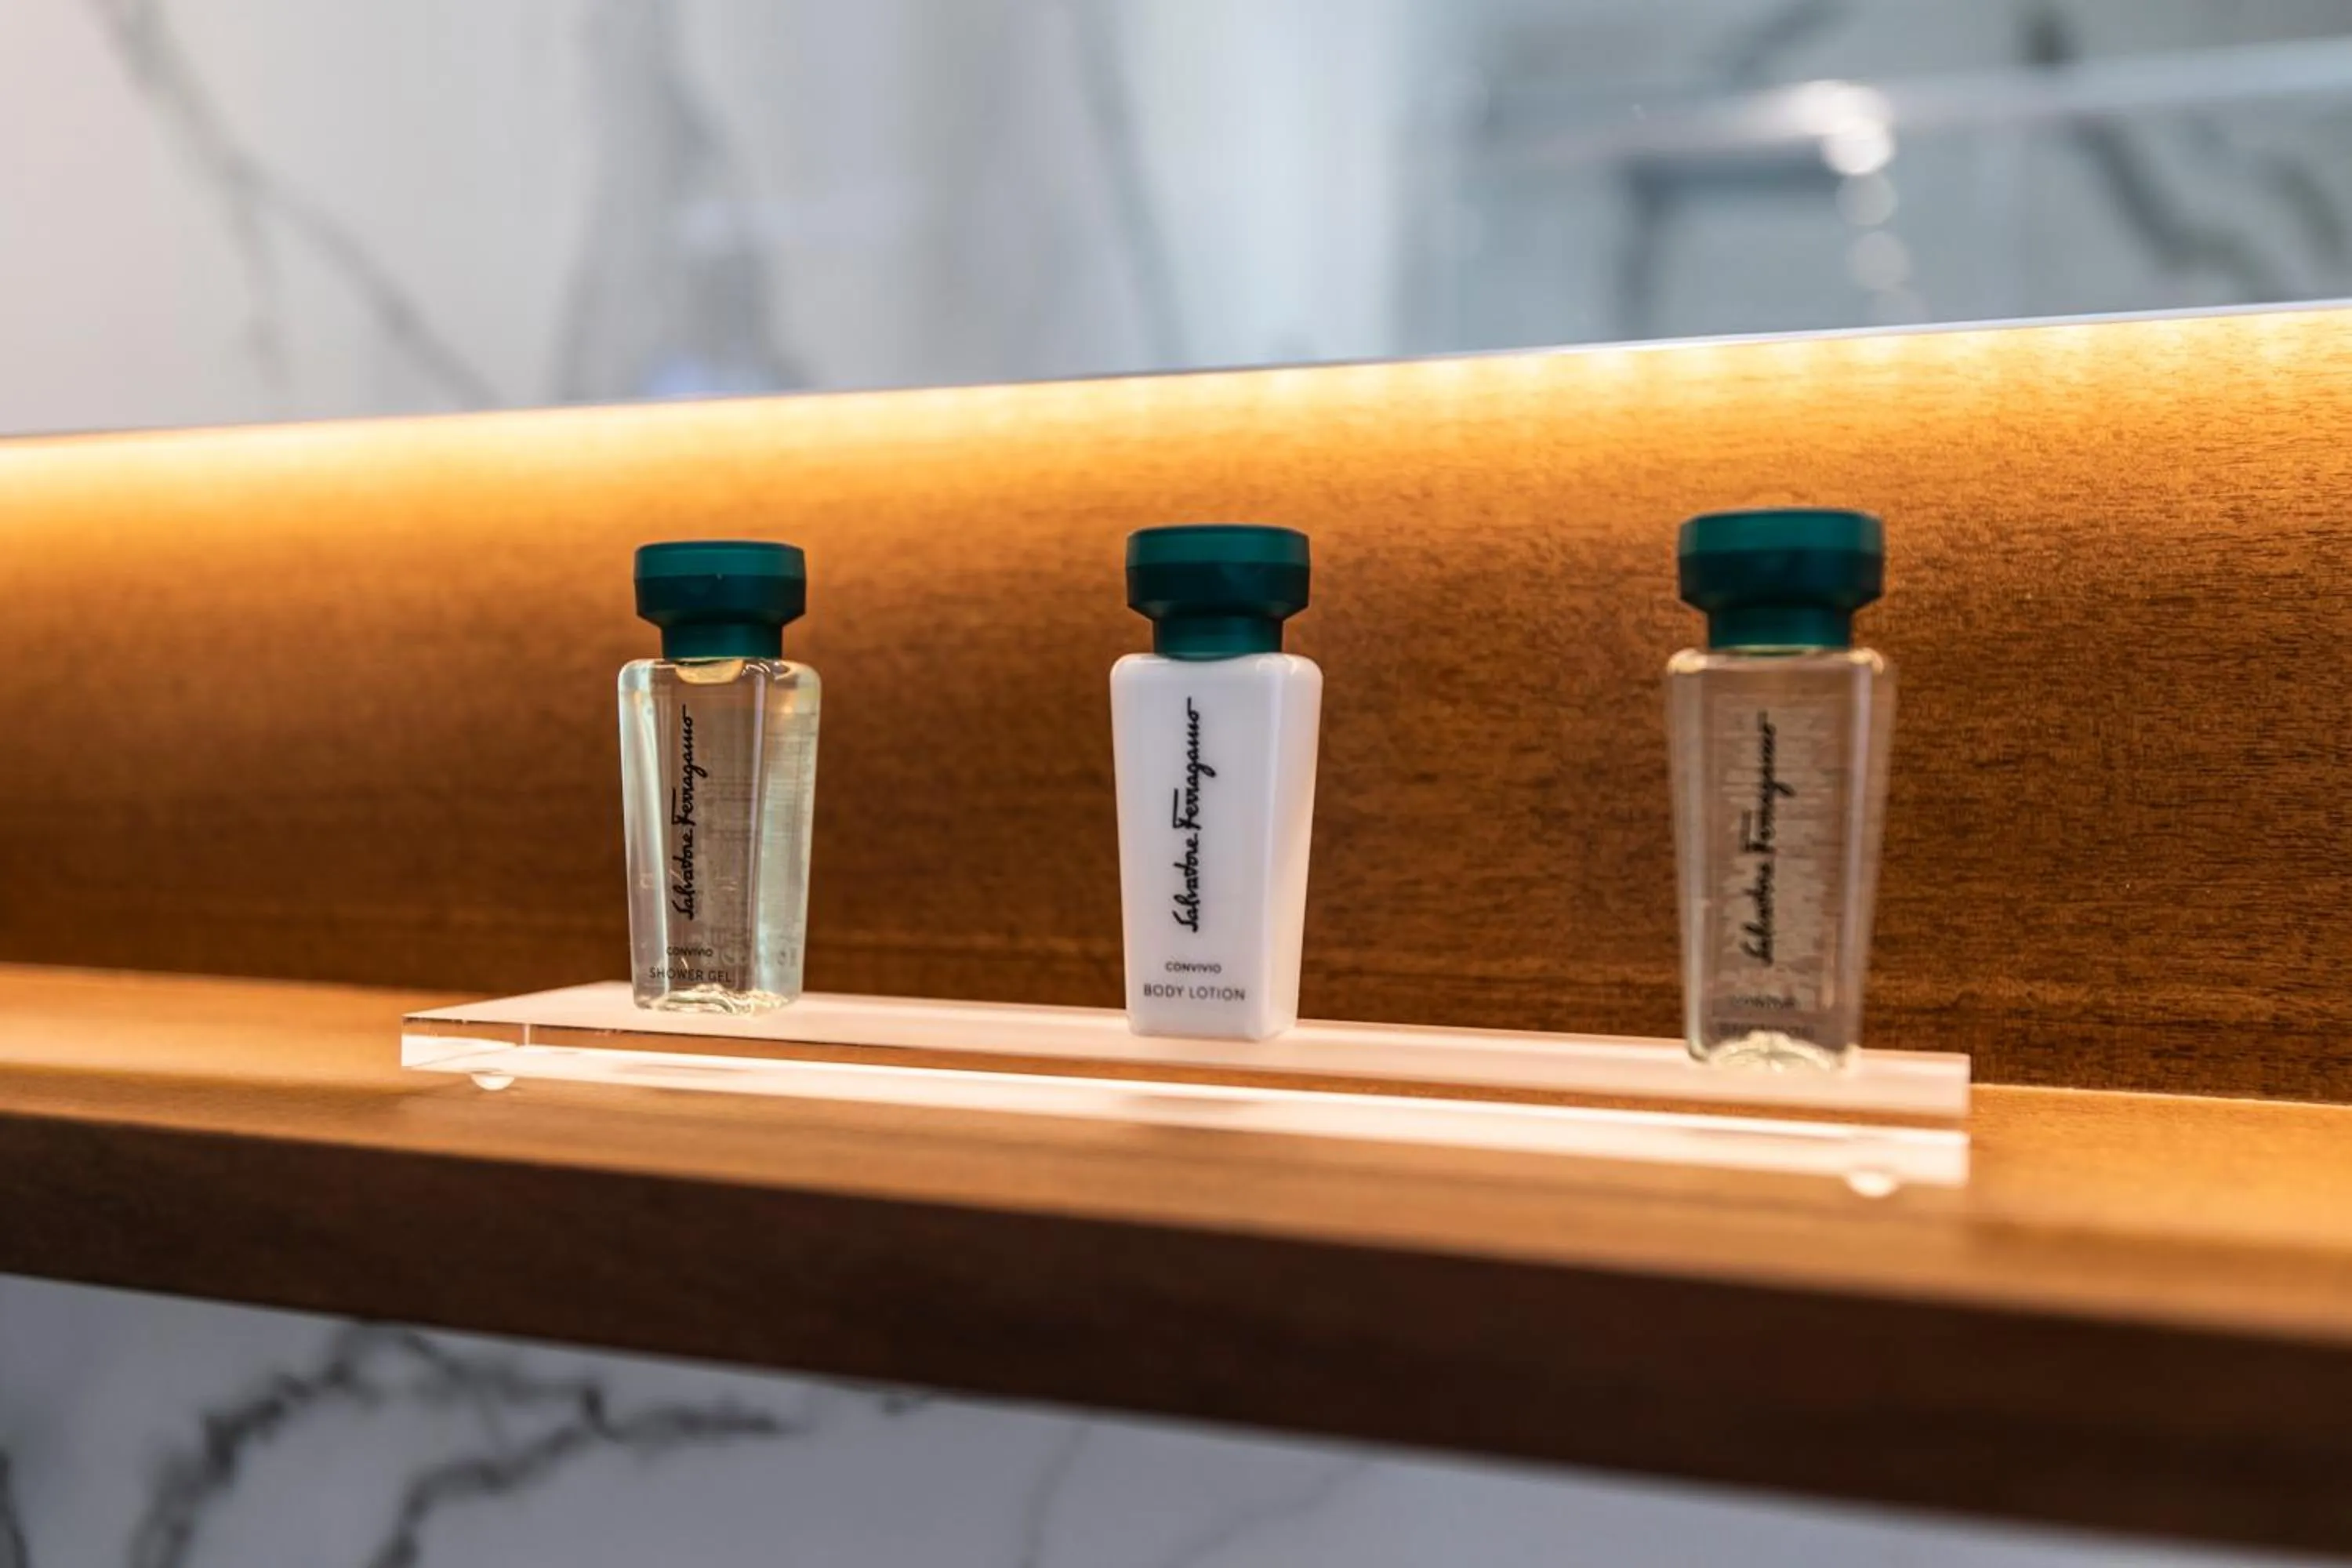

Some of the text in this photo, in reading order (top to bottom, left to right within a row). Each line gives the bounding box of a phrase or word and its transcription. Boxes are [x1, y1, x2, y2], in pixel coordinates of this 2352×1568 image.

[671, 704, 708, 920] Salvatore Ferragamo
[1172, 697, 1216, 933] Salvatore Ferragamo
[649, 967, 732, 983] SHOWER GEL
[1165, 961, 1222, 974] CONVIVIO
[1143, 983, 1246, 1001] BODY LOTION
